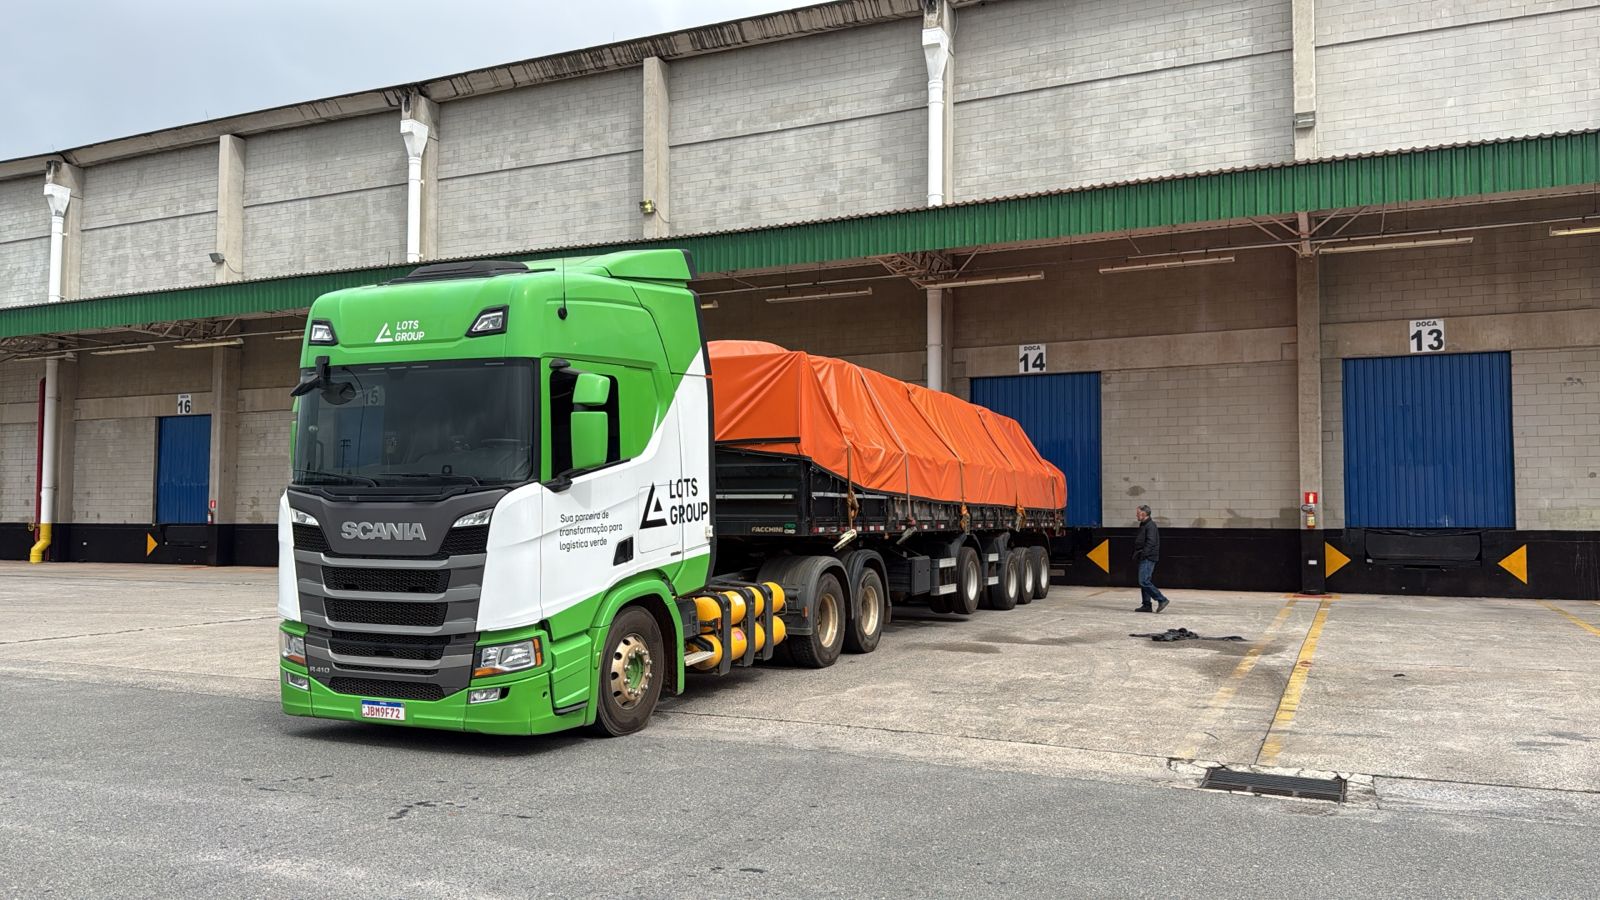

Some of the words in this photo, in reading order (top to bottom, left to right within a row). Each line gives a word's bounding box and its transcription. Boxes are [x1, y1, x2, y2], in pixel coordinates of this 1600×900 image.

[397, 320, 419, 330] LOTS
[395, 331, 425, 342] GROUP
[1411, 329, 1443, 351] 13
[1020, 352, 1045, 372] 14
[178, 399, 191, 413] 16
[669, 477, 698, 499] LOTS
[560, 513, 574, 523] Sua
[575, 511, 600, 523] parceira
[602, 510, 609, 519] de
[670, 502, 708, 525] GROUP
[341, 521, 427, 541] SCANIA
[560, 524, 608, 537] transformação
[609, 523, 623, 534] para
[590, 537, 607, 547] verde
[365, 706, 400, 719] JBM9F72
